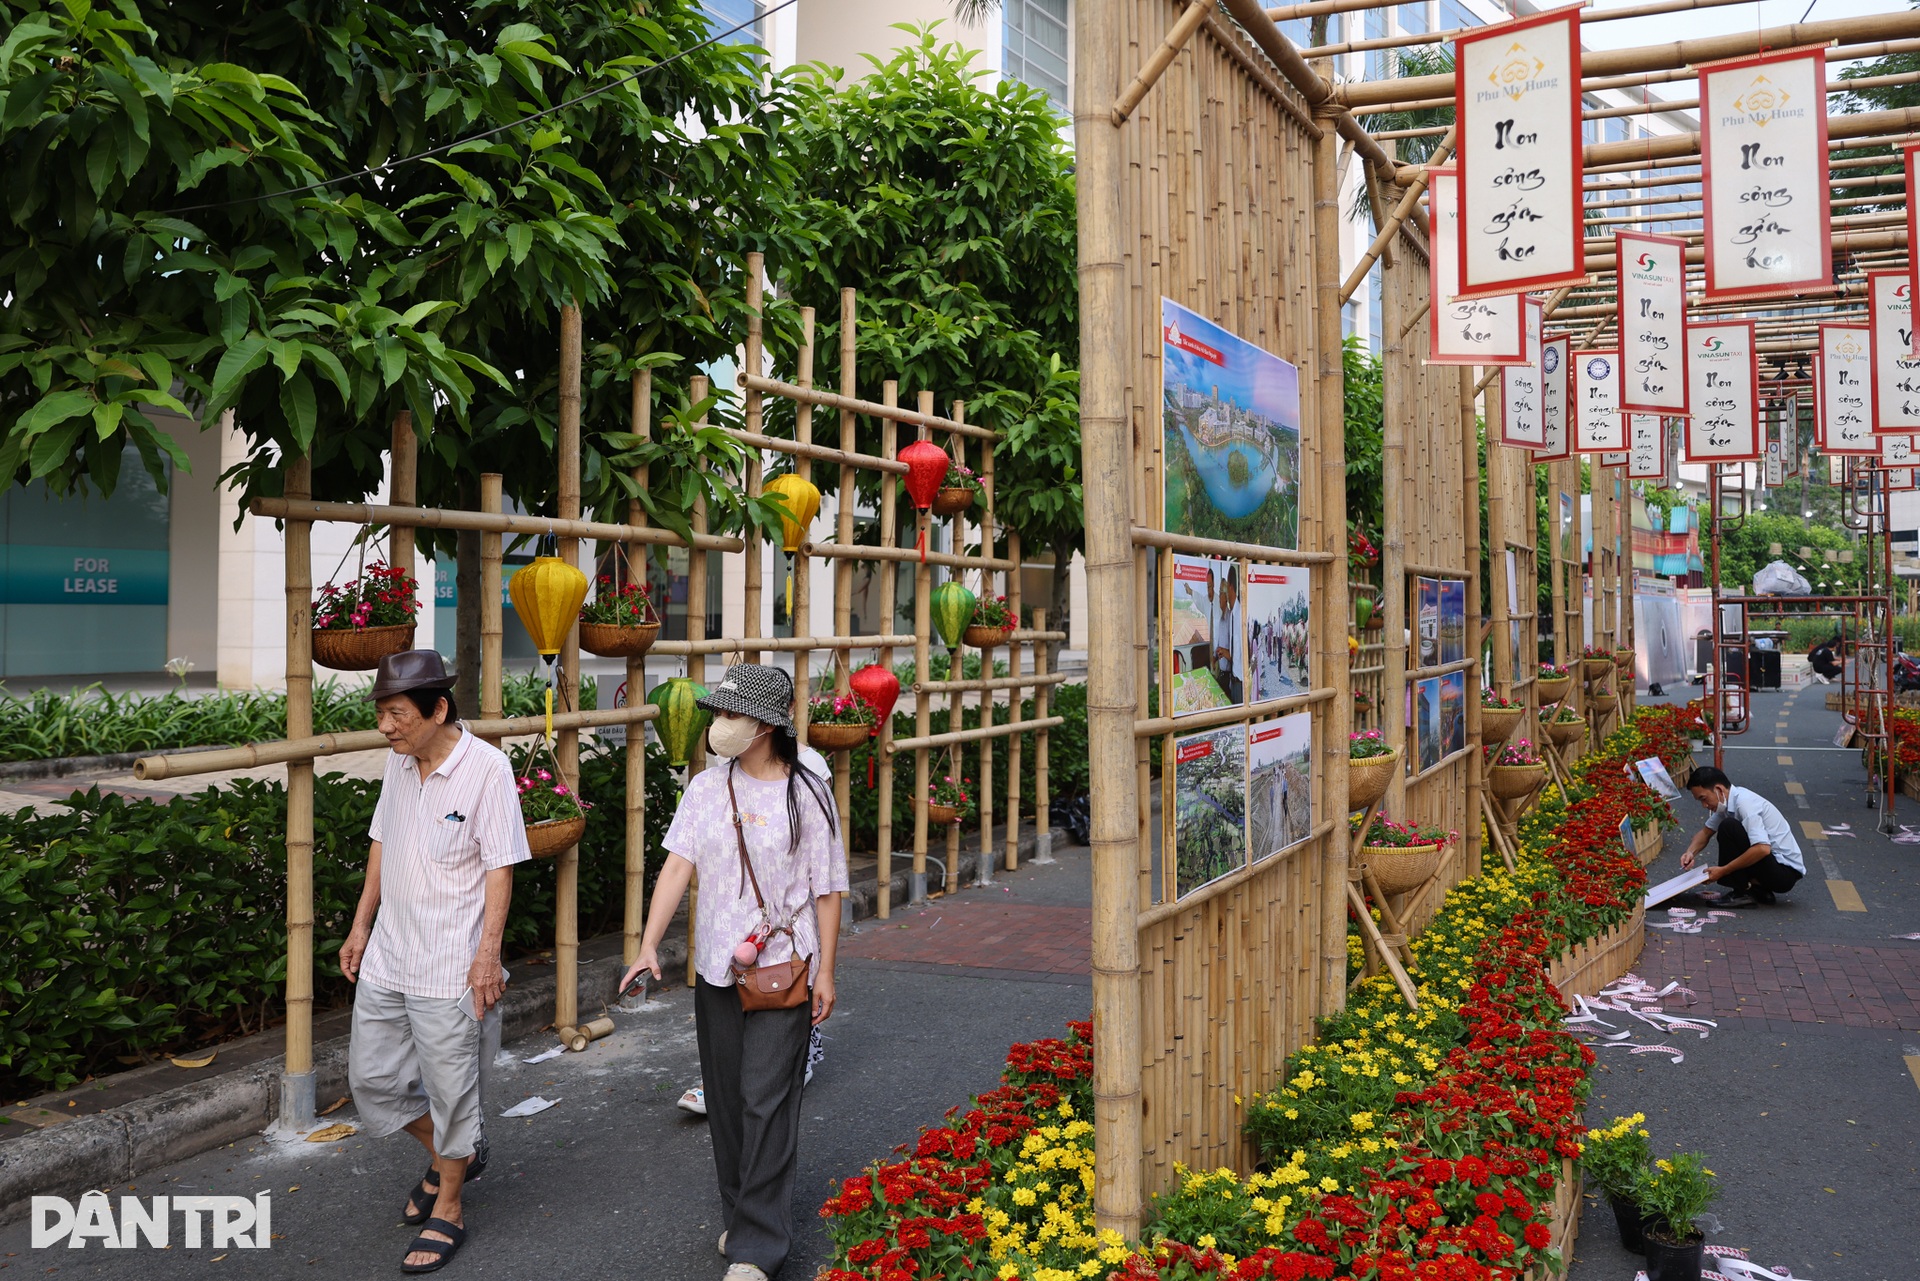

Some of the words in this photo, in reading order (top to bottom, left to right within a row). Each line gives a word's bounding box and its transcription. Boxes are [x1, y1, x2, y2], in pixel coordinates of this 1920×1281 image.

[1477, 90, 1499, 103] Phu
[1502, 85, 1522, 98] My
[1525, 78, 1559, 92] Hung
[1721, 116, 1745, 127] Phu
[1748, 112, 1768, 124] My
[1771, 108, 1805, 120] Hung
[1491, 167, 1546, 191] sông
[1738, 185, 1793, 207] sông
[1632, 272, 1663, 282] VINASUN
[1639, 331, 1669, 350] sông
[1546, 405, 1558, 416] ông
[1704, 397, 1736, 411] sông
[73, 558, 109, 573] FOR
[64, 578, 118, 593] LEASE
